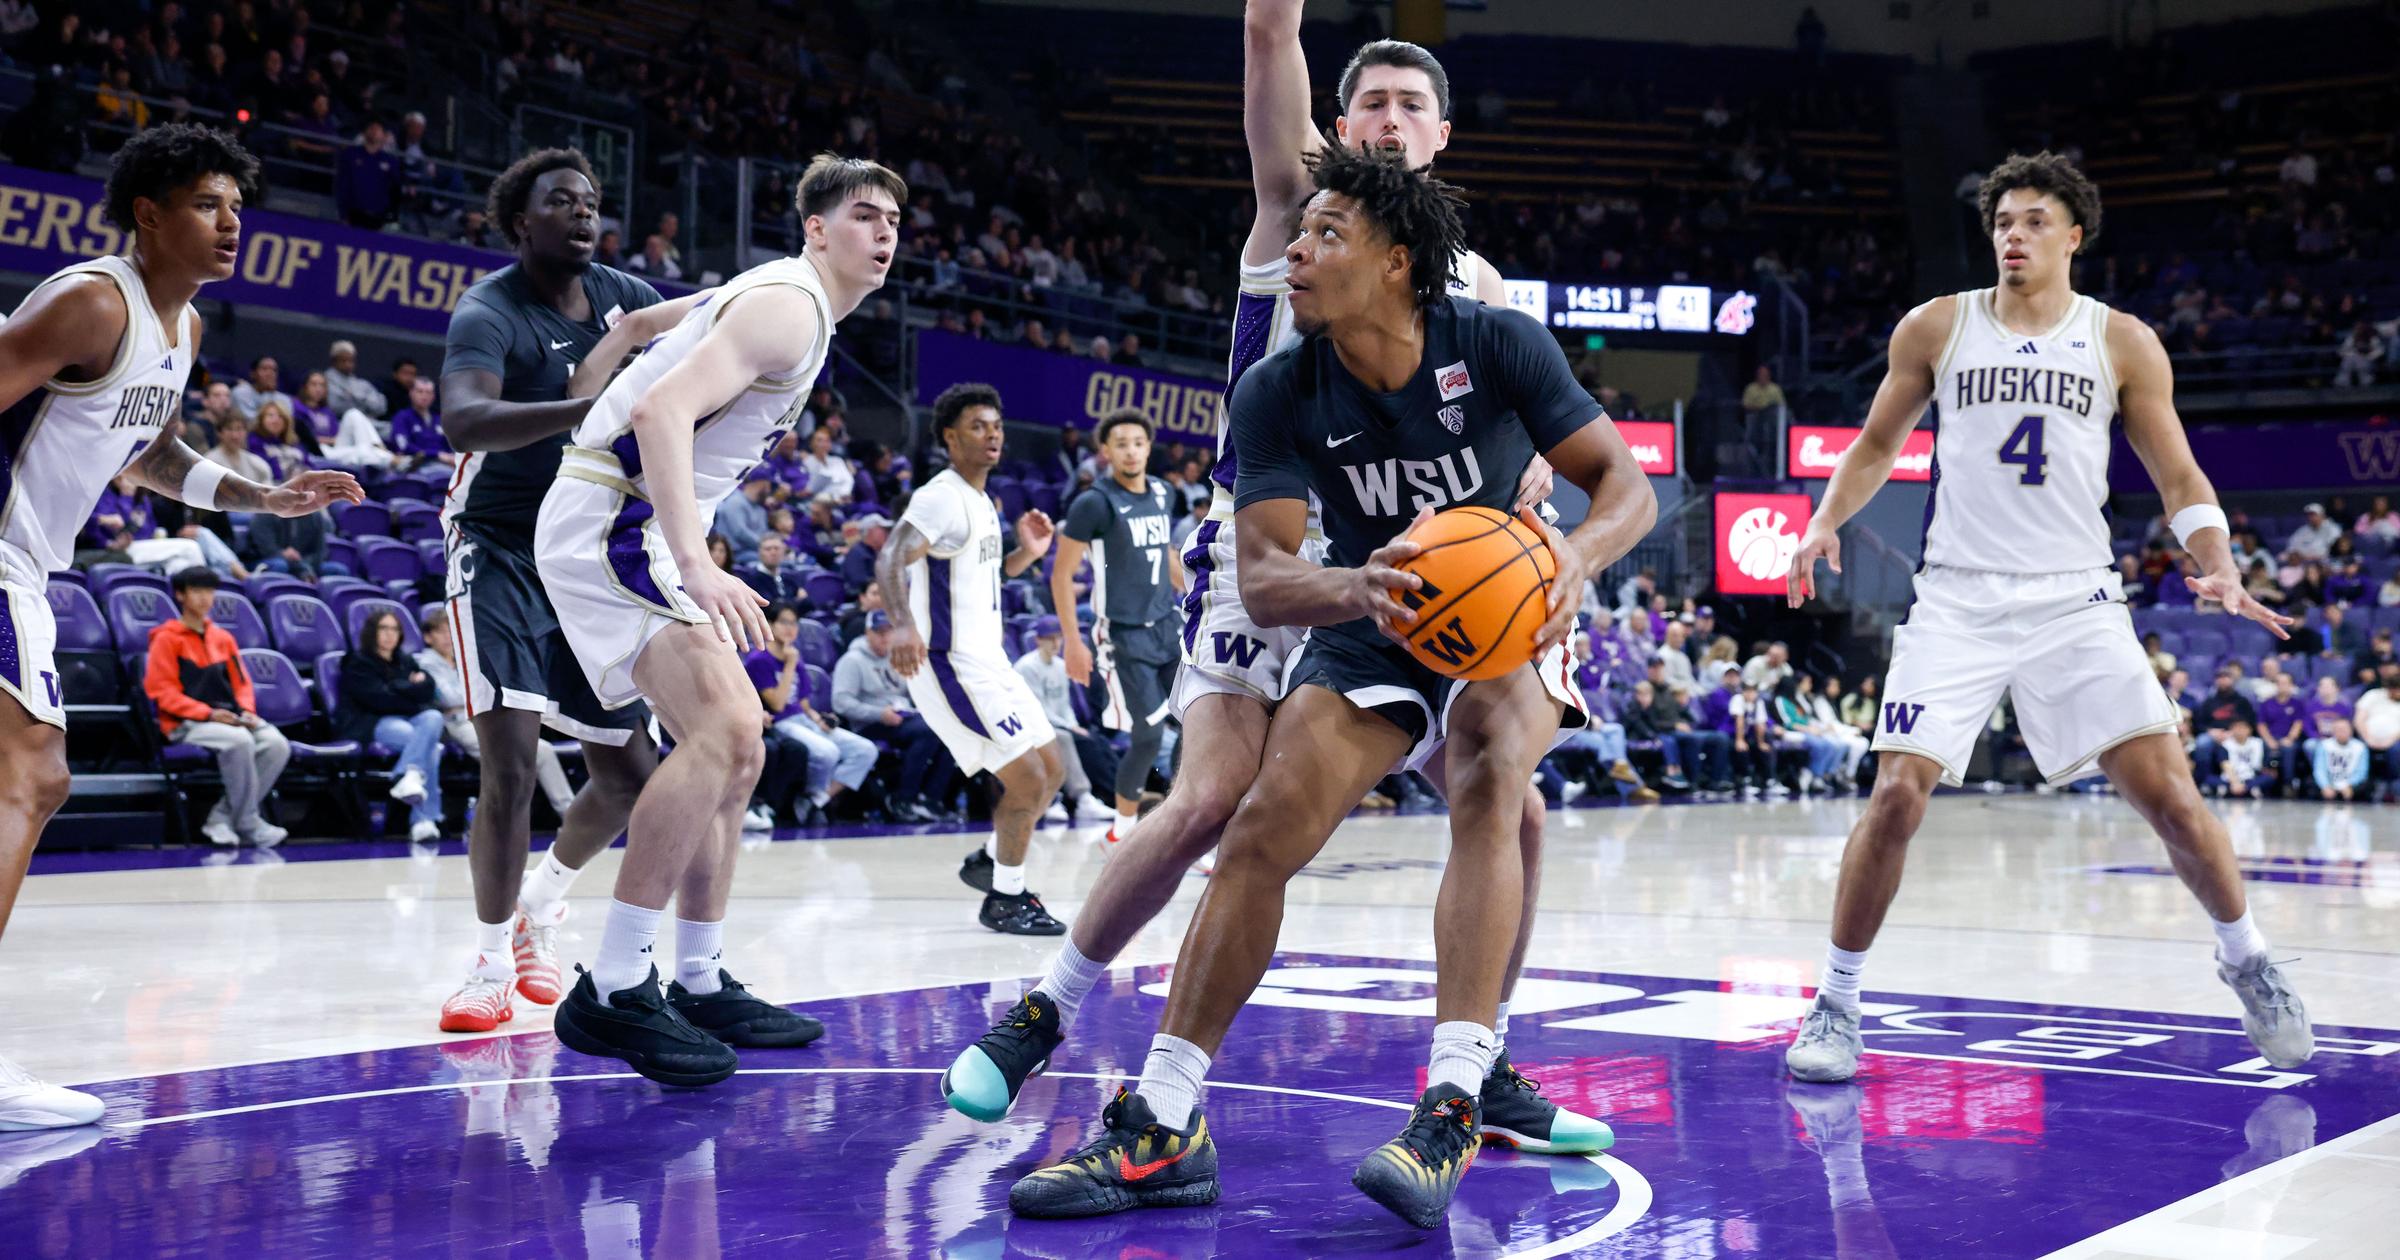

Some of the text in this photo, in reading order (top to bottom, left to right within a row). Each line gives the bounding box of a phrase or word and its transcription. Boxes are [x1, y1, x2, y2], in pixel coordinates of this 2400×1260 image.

[242, 231, 323, 288] OF
[110, 385, 180, 430] HUSKI
[1085, 371, 1136, 419] GO
[1957, 366, 2096, 418] HUSKIES
[1999, 415, 2048, 485] 4
[2336, 430, 2400, 480] W
[1340, 446, 1484, 516] WSU
[1127, 513, 1171, 548] WSU
[1144, 548, 1163, 586] 7
[1210, 631, 1268, 670] W
[1420, 615, 1478, 667] W
[996, 711, 1024, 737] W
[1884, 702, 1926, 735] W
